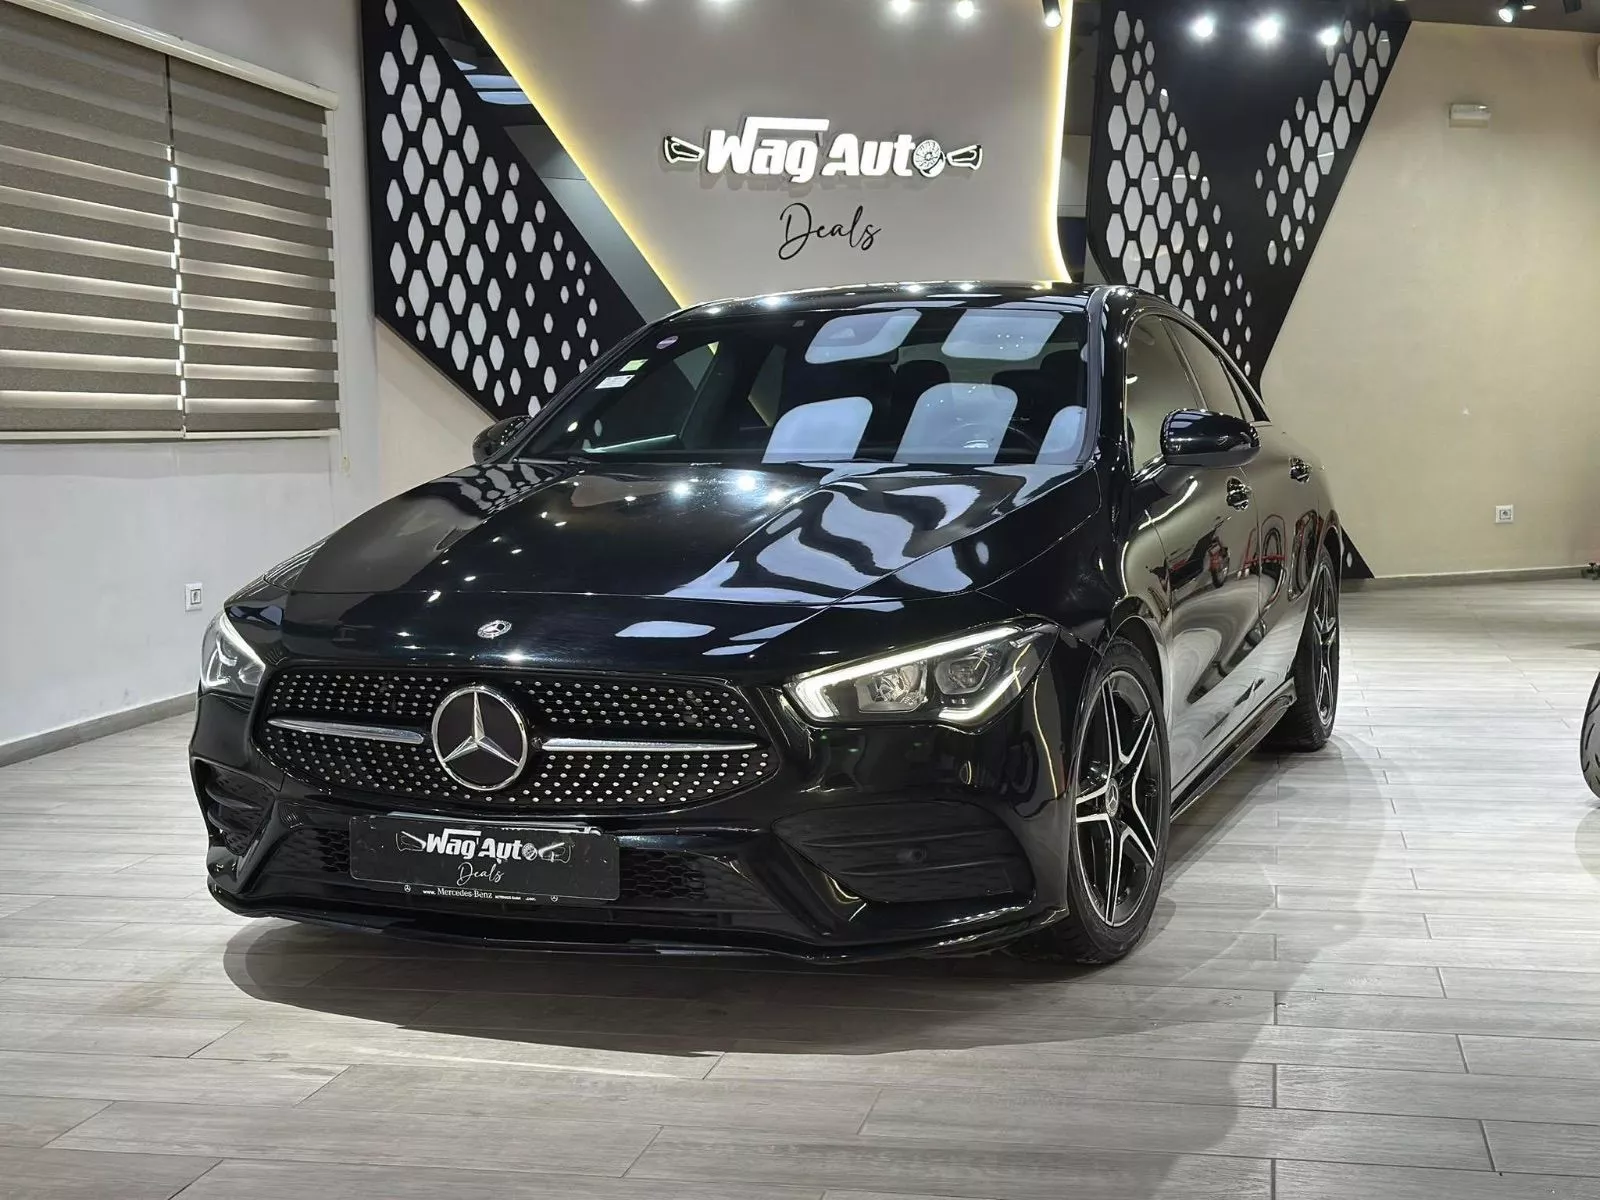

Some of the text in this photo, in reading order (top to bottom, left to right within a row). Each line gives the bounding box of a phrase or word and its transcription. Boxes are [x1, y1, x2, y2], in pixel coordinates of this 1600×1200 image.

[707, 116, 829, 183] Wag
[778, 202, 882, 260] Deals
[426, 828, 482, 860] Wag
[456, 861, 504, 886] Deals
[437, 887, 493, 899] Mercedes-Benz
